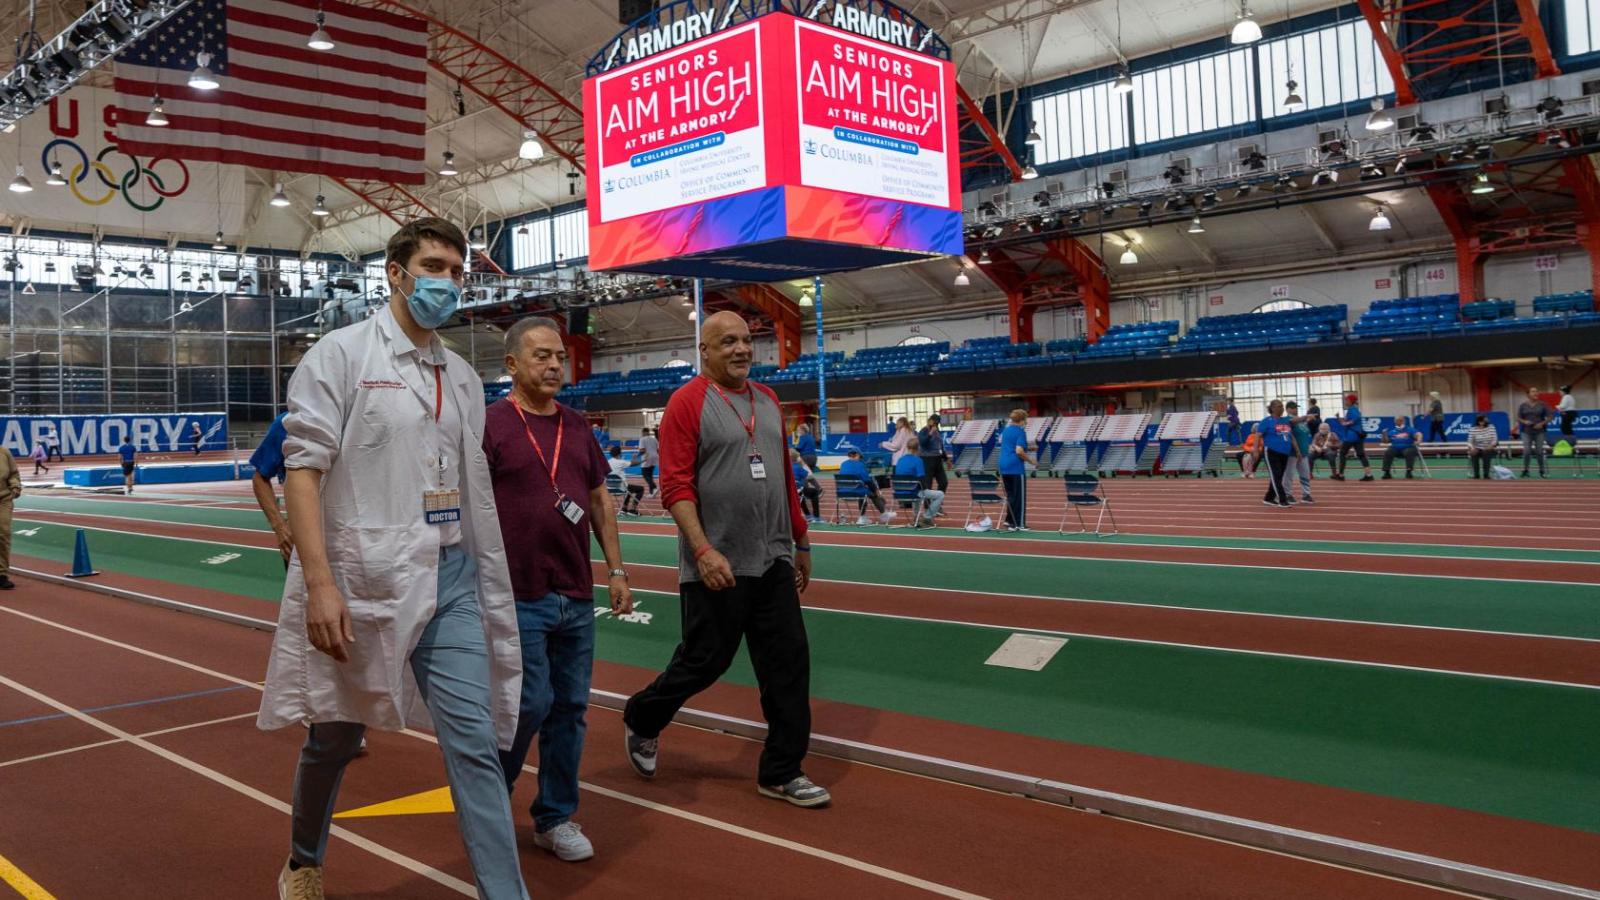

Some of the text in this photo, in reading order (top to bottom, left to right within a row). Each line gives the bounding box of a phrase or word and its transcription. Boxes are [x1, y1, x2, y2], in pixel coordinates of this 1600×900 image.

[626, 8, 715, 62] ARMORY
[833, 3, 914, 49] ARMORY
[631, 50, 718, 91] SENIORS
[833, 44, 913, 79] SENIORS
[605, 61, 751, 138] AIM HIGH
[806, 60, 937, 122] AIM HIGH
[625, 111, 727, 149] AT THE ARMORY
[828, 108, 920, 135] AT THE ARMORY
[633, 136, 721, 165] IN COLLABORATION WITH
[847, 132, 899, 149] COLLABORATION
[901, 143, 916, 152] WITH
[1272, 287, 1288, 297] 447
[1426, 269, 1445, 281] 448
[1, 418, 188, 456] ARMORY
[428, 511, 459, 523] DOCTOR
